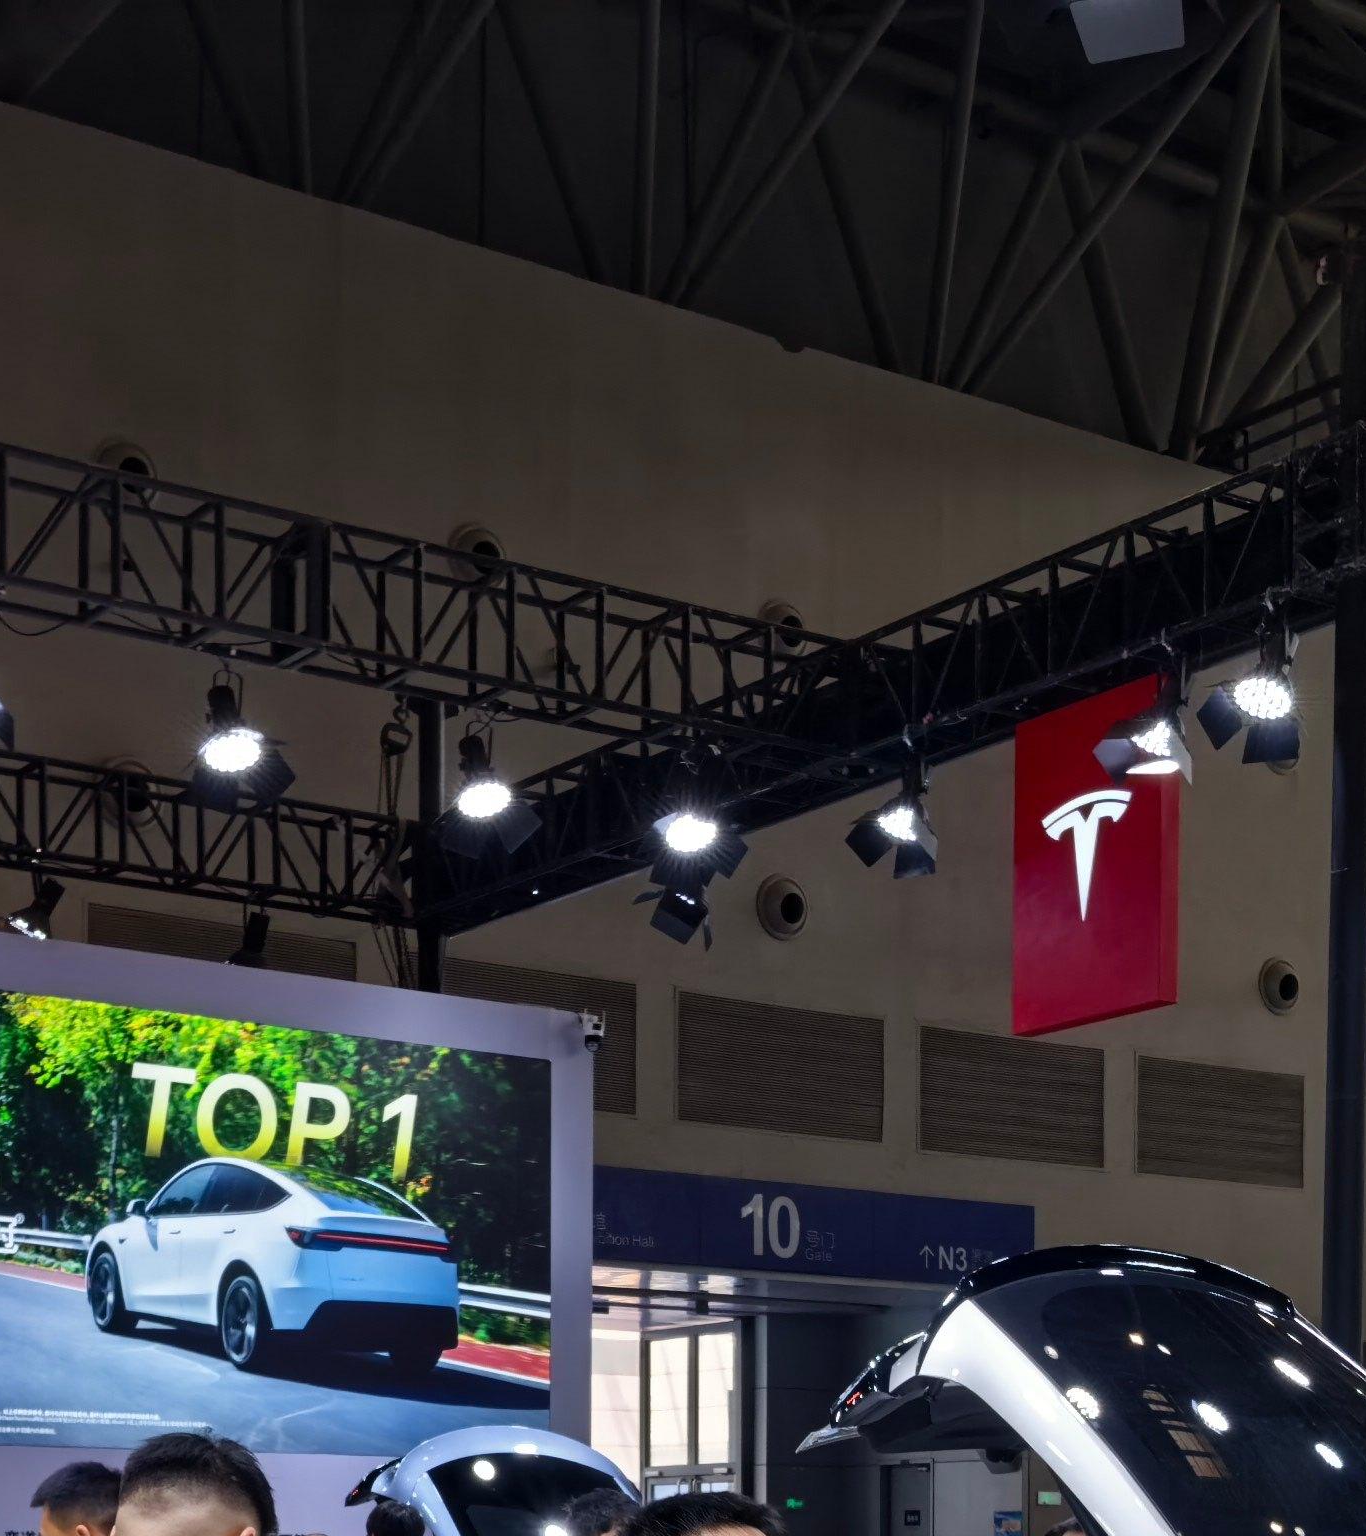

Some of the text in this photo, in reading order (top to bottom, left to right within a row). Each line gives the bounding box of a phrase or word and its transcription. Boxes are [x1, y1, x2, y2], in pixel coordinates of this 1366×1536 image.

[131, 1062, 418, 1182] TOP 1
[740, 1193, 800, 1259] 10
[934, 1245, 968, 1272] N3
